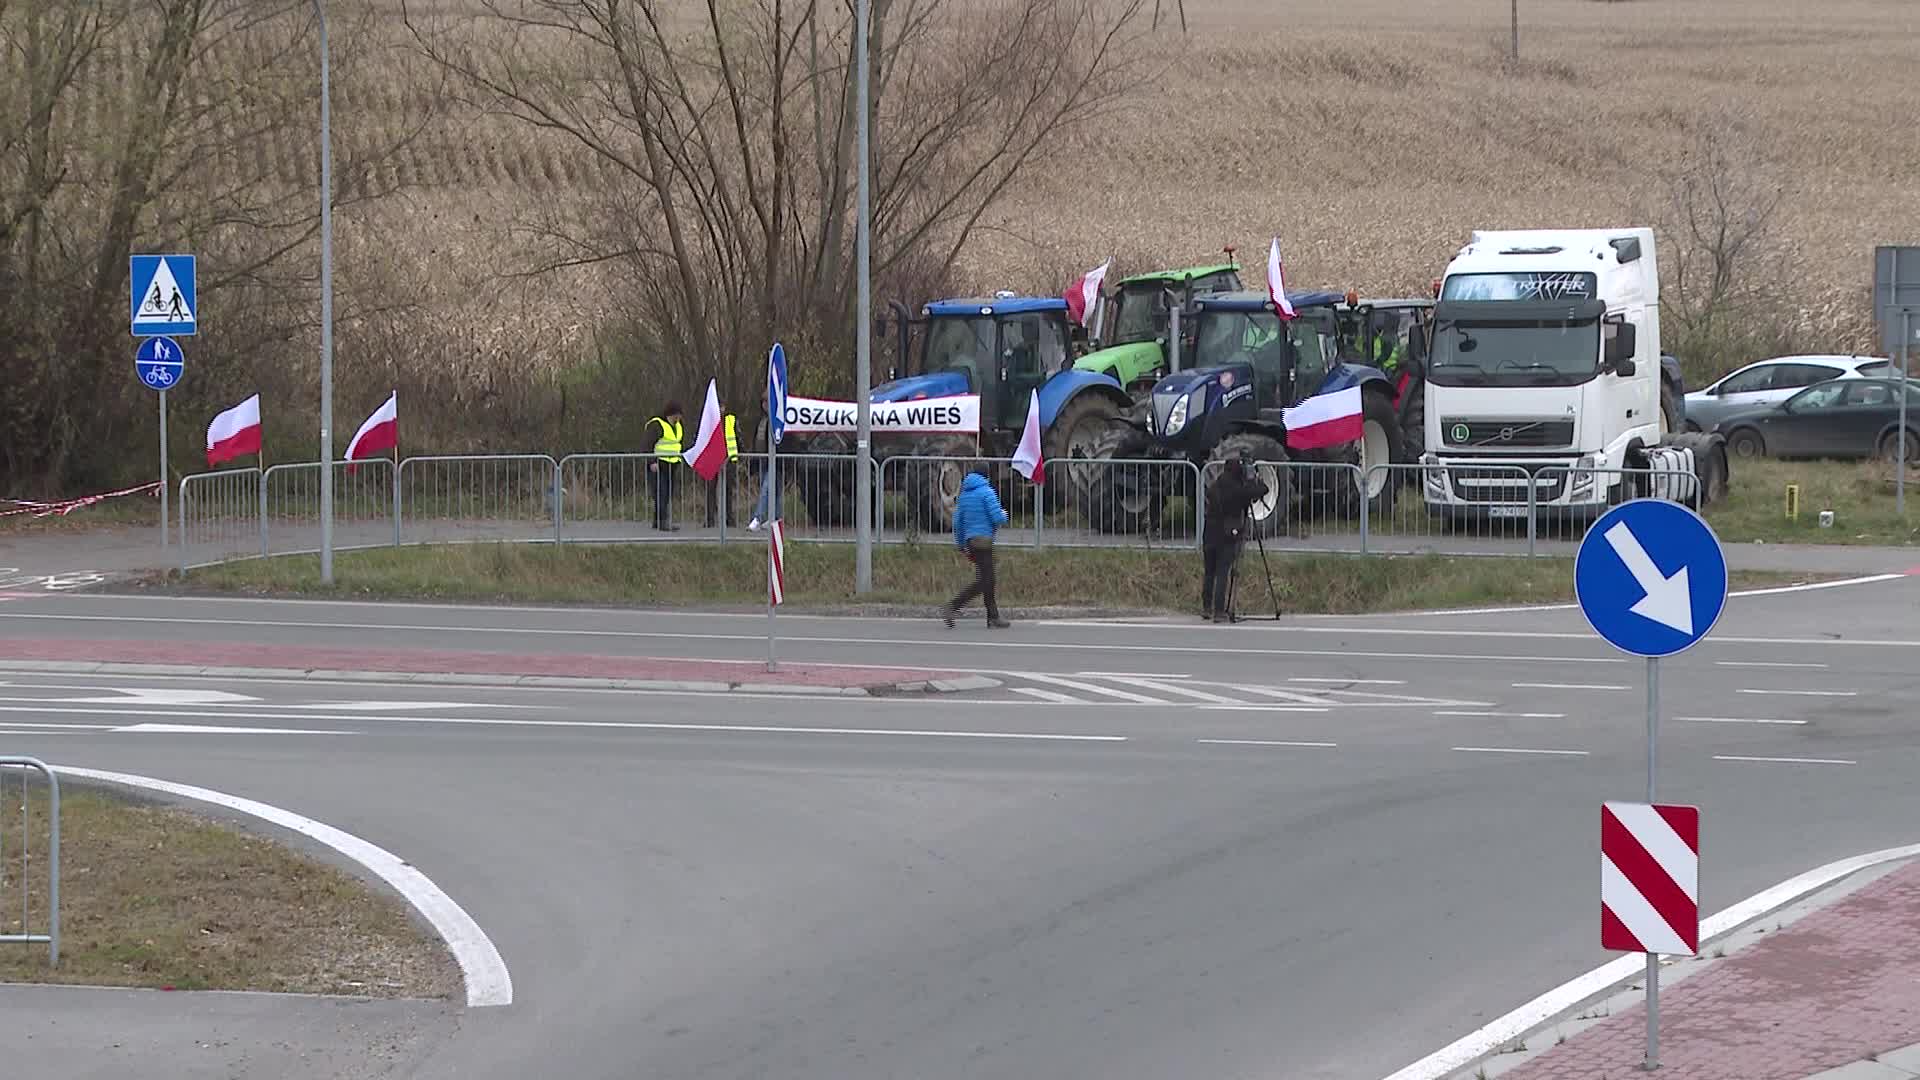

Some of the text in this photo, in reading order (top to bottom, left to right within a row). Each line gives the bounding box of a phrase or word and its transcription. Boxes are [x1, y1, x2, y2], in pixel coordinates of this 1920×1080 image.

[785, 402, 962, 426] OSZUKNA WIEŚ
[1455, 427, 1465, 439] L
